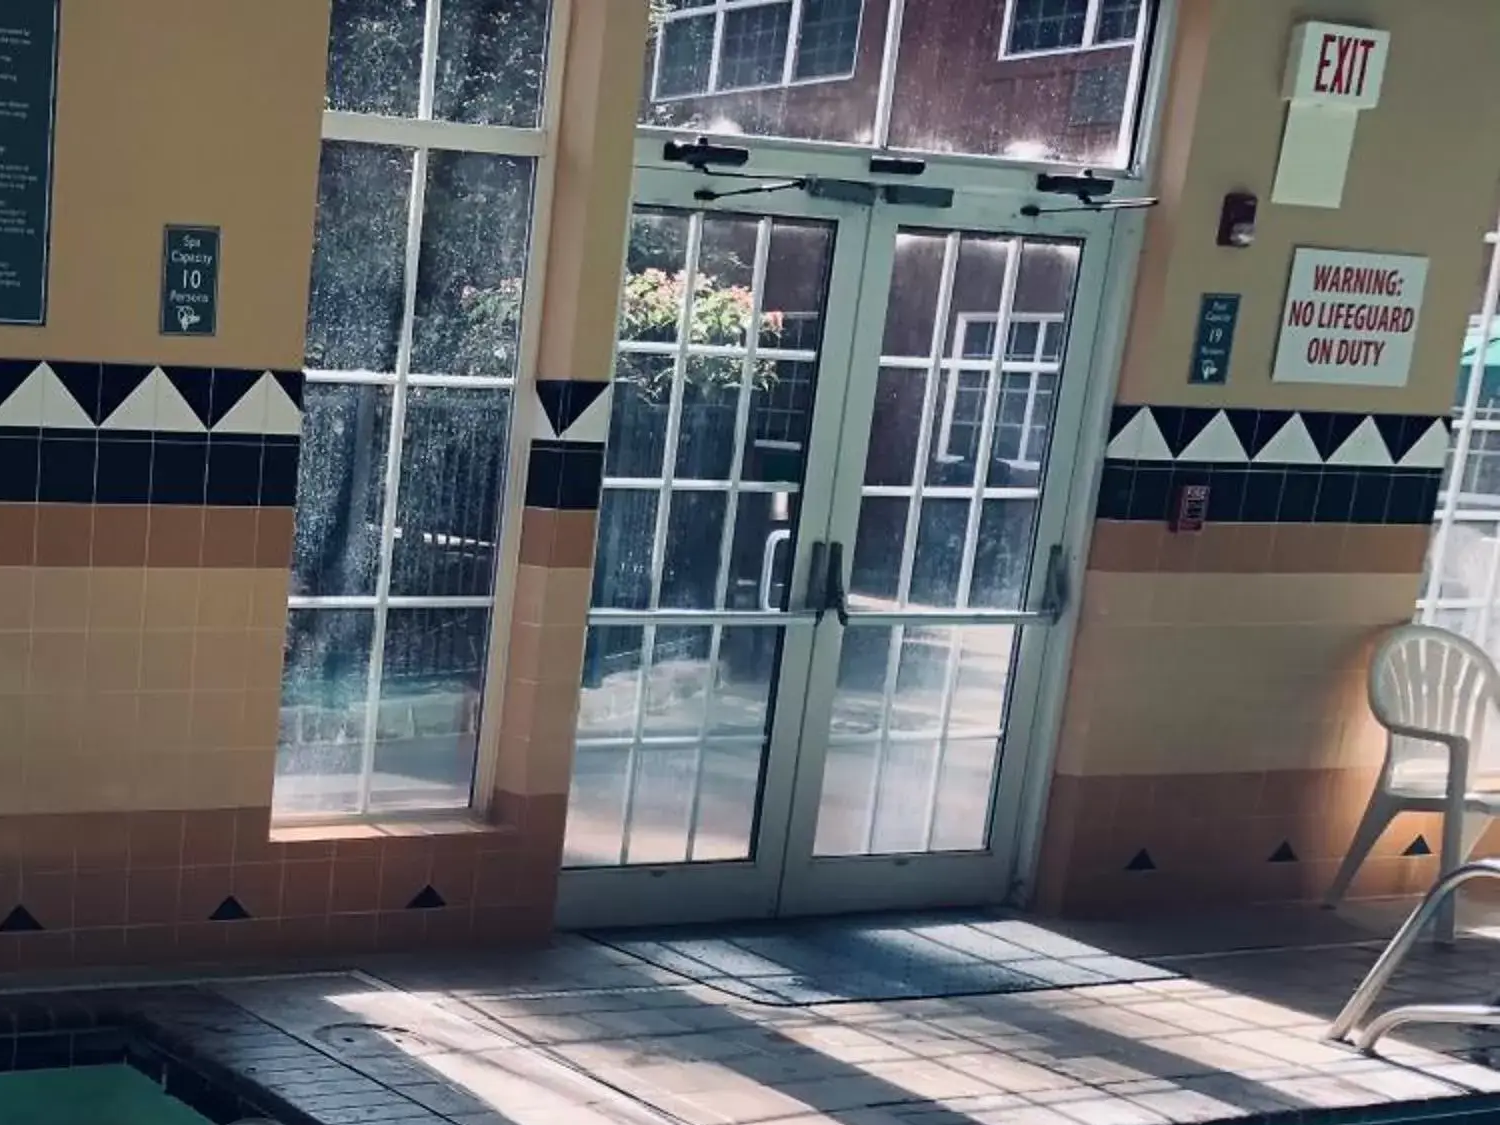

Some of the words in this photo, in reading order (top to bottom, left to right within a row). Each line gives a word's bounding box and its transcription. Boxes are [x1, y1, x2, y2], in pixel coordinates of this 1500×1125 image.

[1315, 34, 1375, 96] EXIT
[183, 269, 201, 289] 10
[1314, 265, 1404, 296] WARNING:
[1288, 300, 1315, 327] NO
[1318, 302, 1415, 333] LIFEGUARD
[1307, 338, 1333, 364] ON
[1336, 340, 1385, 366] DUTY
